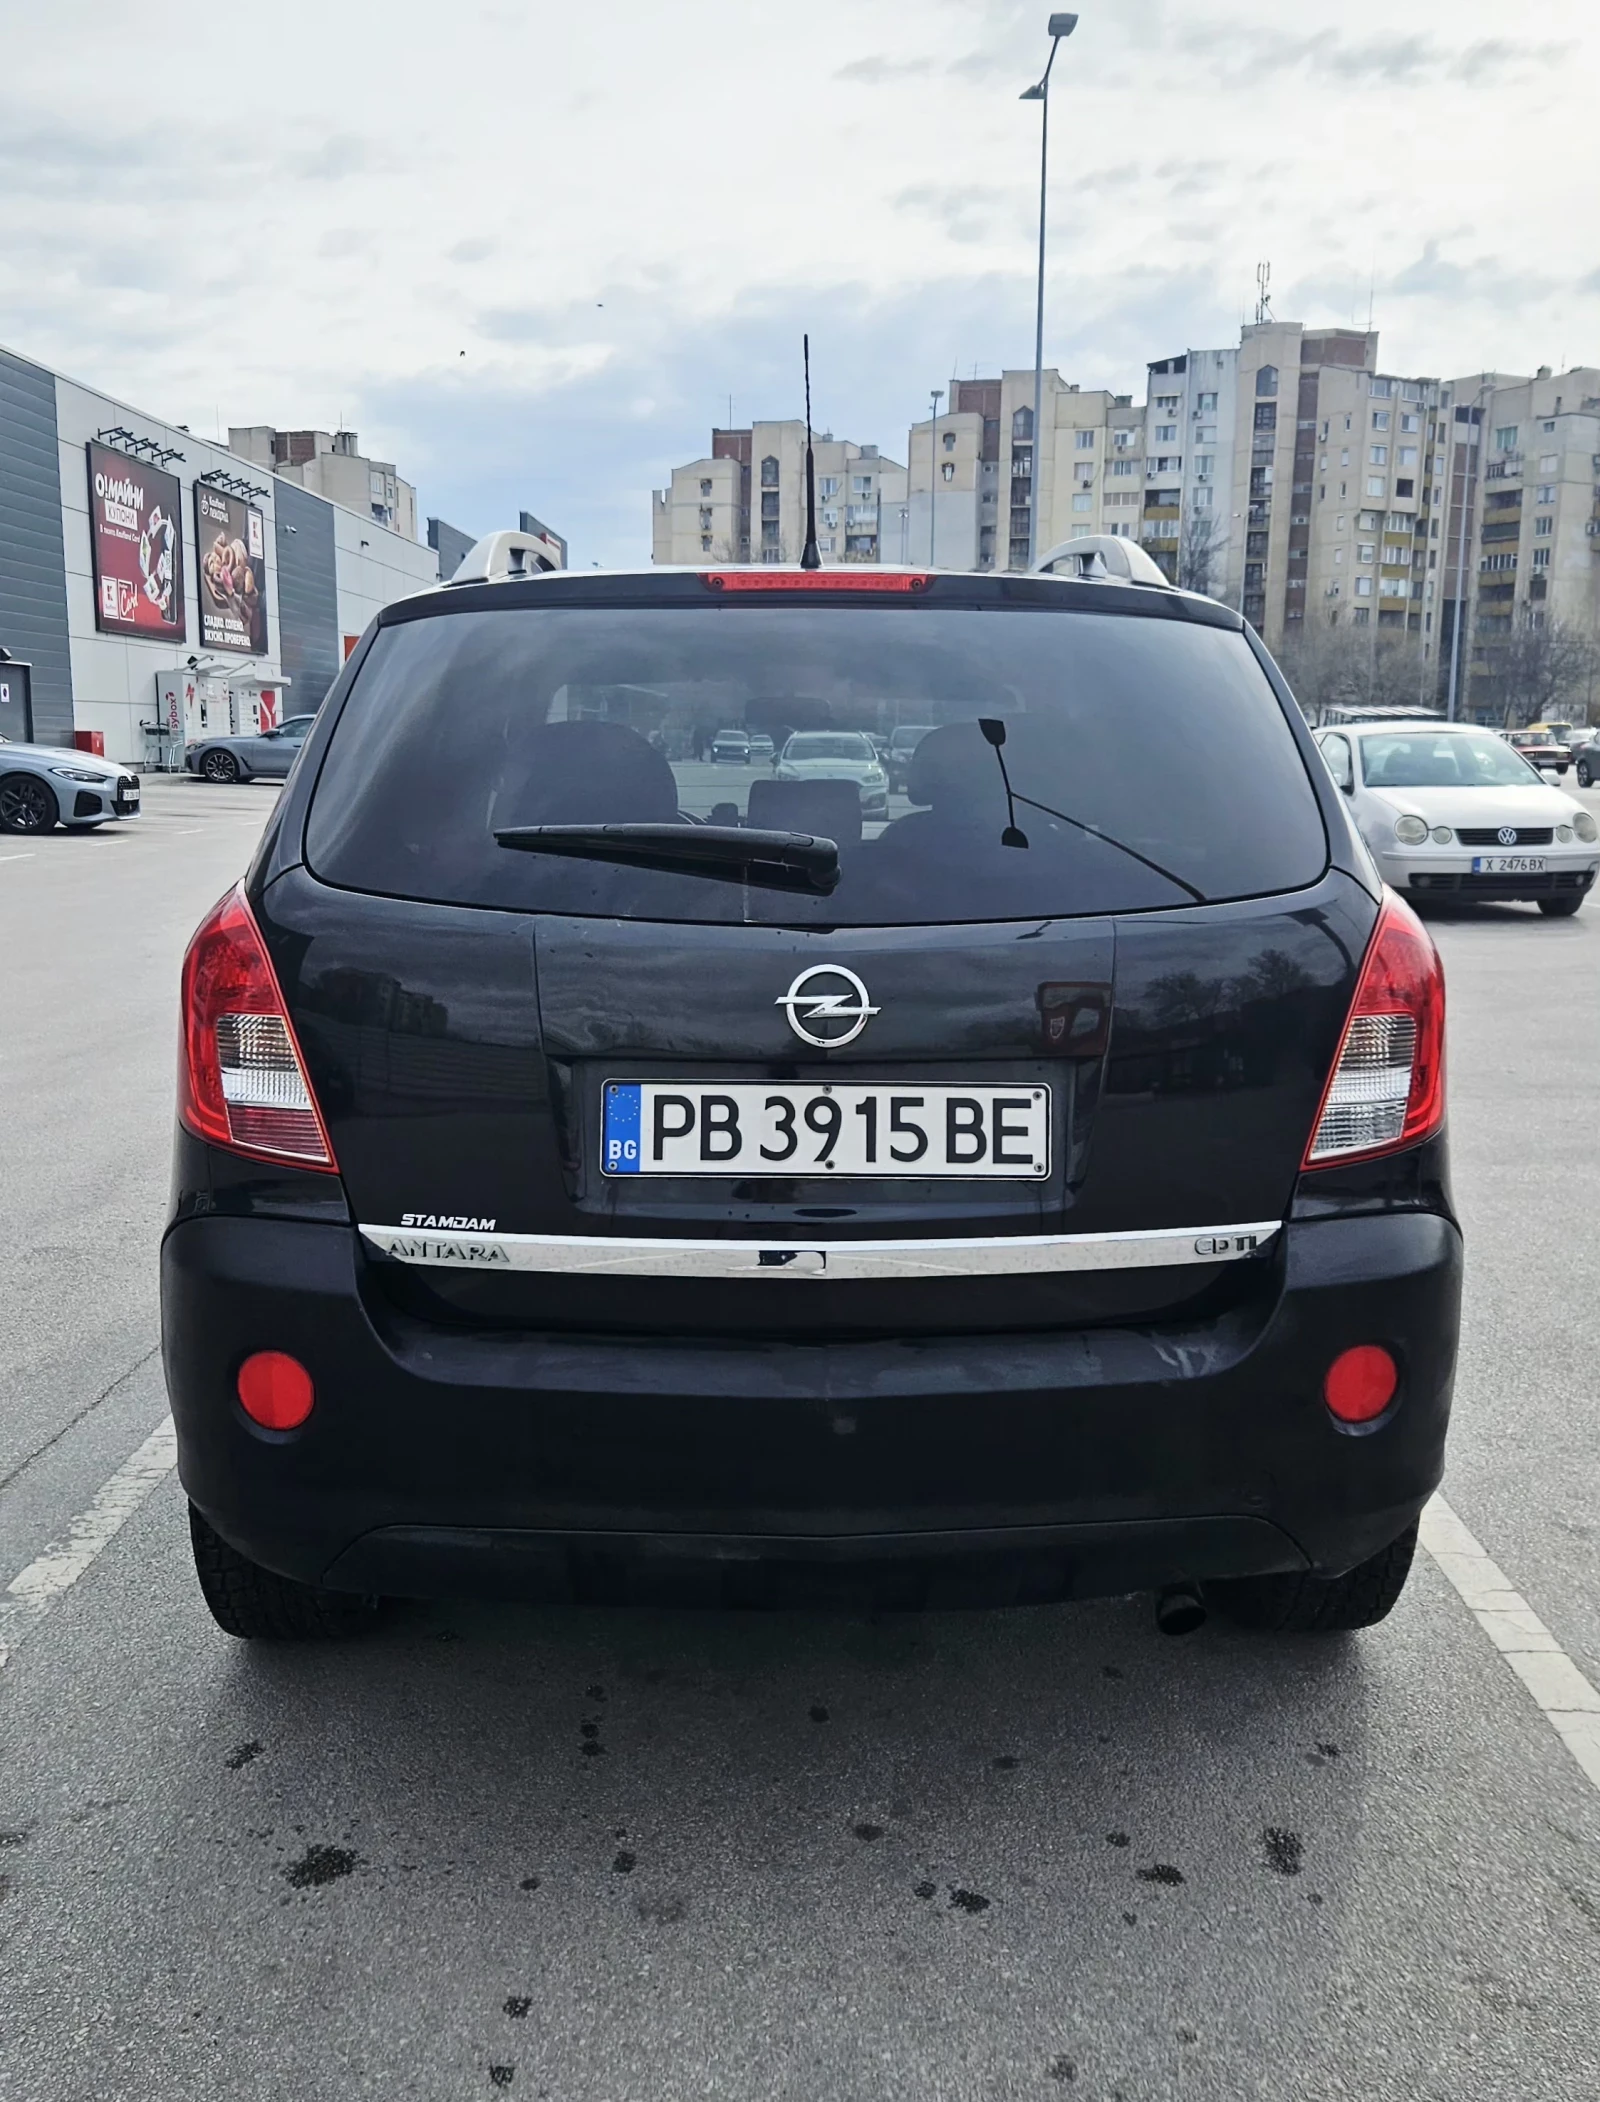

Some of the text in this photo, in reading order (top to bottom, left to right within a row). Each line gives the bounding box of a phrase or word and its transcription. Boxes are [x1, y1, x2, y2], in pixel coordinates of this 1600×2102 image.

[108, 506, 136, 526] КУПОНИ
[1499, 859, 1528, 871] 2476
[1529, 859, 1544, 871] BX
[652, 1094, 1034, 1164] PB 3915 BE
[608, 1139, 637, 1160] BG
[386, 1239, 510, 1262] ANTARA
